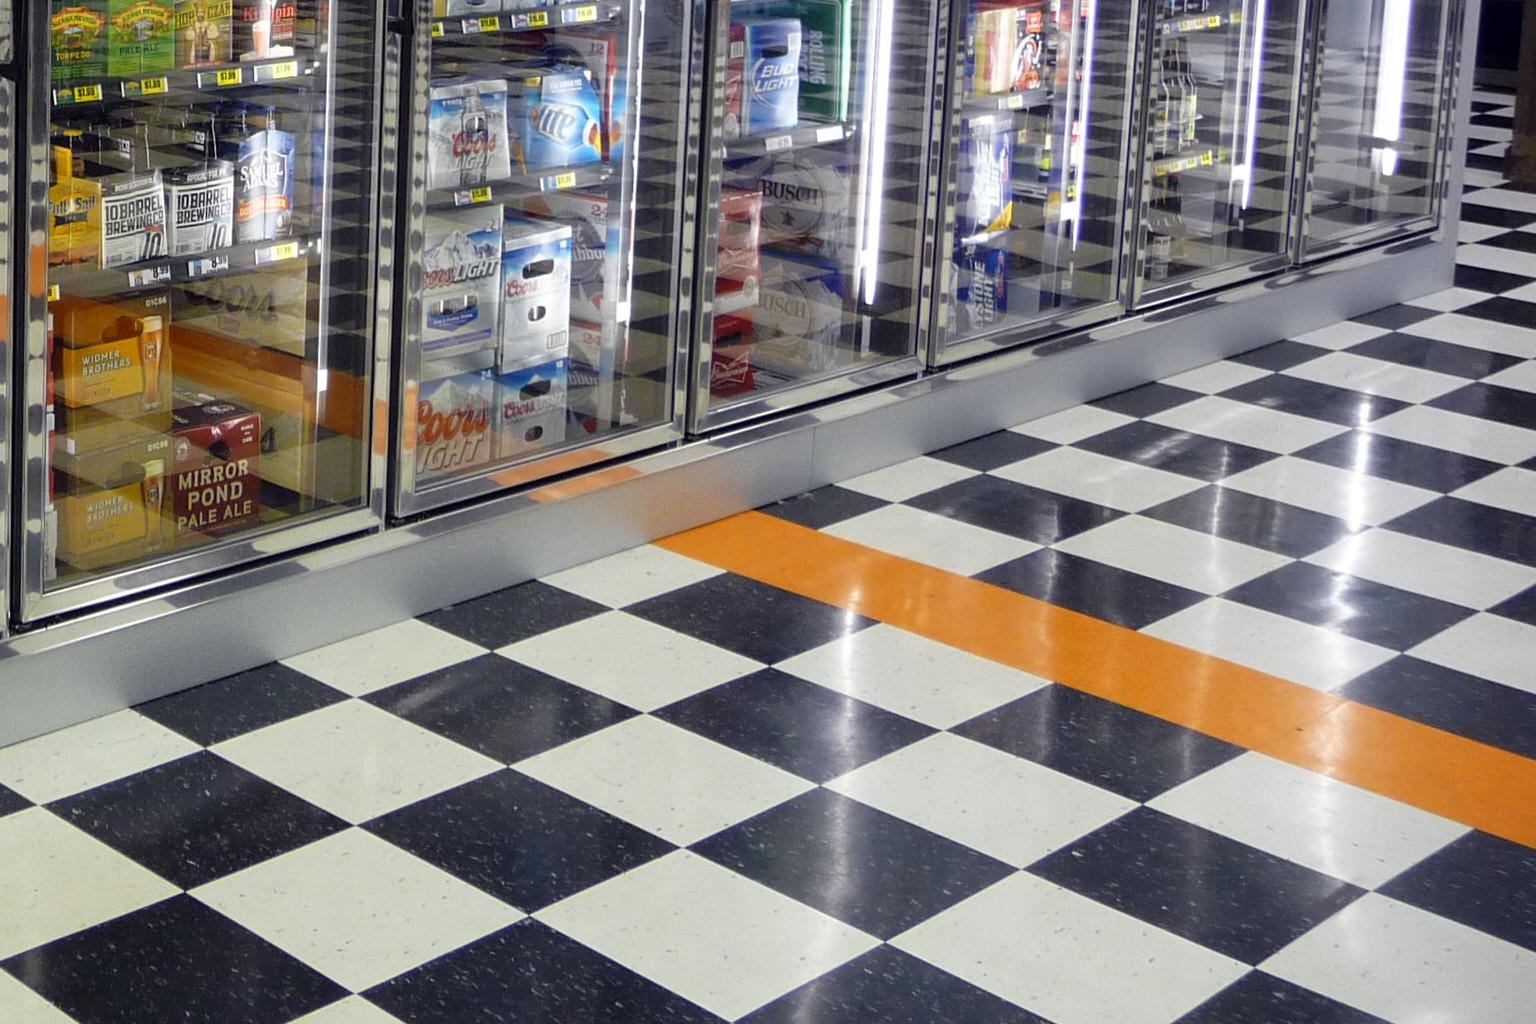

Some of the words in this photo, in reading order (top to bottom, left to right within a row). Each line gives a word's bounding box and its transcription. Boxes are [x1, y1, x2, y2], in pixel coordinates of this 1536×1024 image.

[175, 10, 195, 28] HOP
[207, 2, 232, 22] CZAR
[55, 51, 92, 62] TORPEDO
[119, 46, 141, 56] PALE
[144, 43, 160, 54] ALE
[809, 29, 826, 87] ROLLING
[760, 61, 795, 77] BUD
[752, 75, 798, 93] LIGHT
[452, 129, 497, 159] Coors
[240, 162, 283, 183] SAMUEL
[453, 153, 494, 172] LIGHT
[761, 177, 821, 206] BUSCH
[453, 258, 500, 281] LIGHT
[81, 350, 121, 367] WIDMER
[82, 357, 131, 377] BROTHERS
[504, 400, 535, 420] Coors
[178, 458, 250, 491] MIRROR
[86, 495, 124, 513] WIDMER
[187, 481, 243, 511] POND
[86, 503, 135, 523] BROTHERS
[177, 508, 218, 531] PALE
[223, 500, 253, 517] ALE
